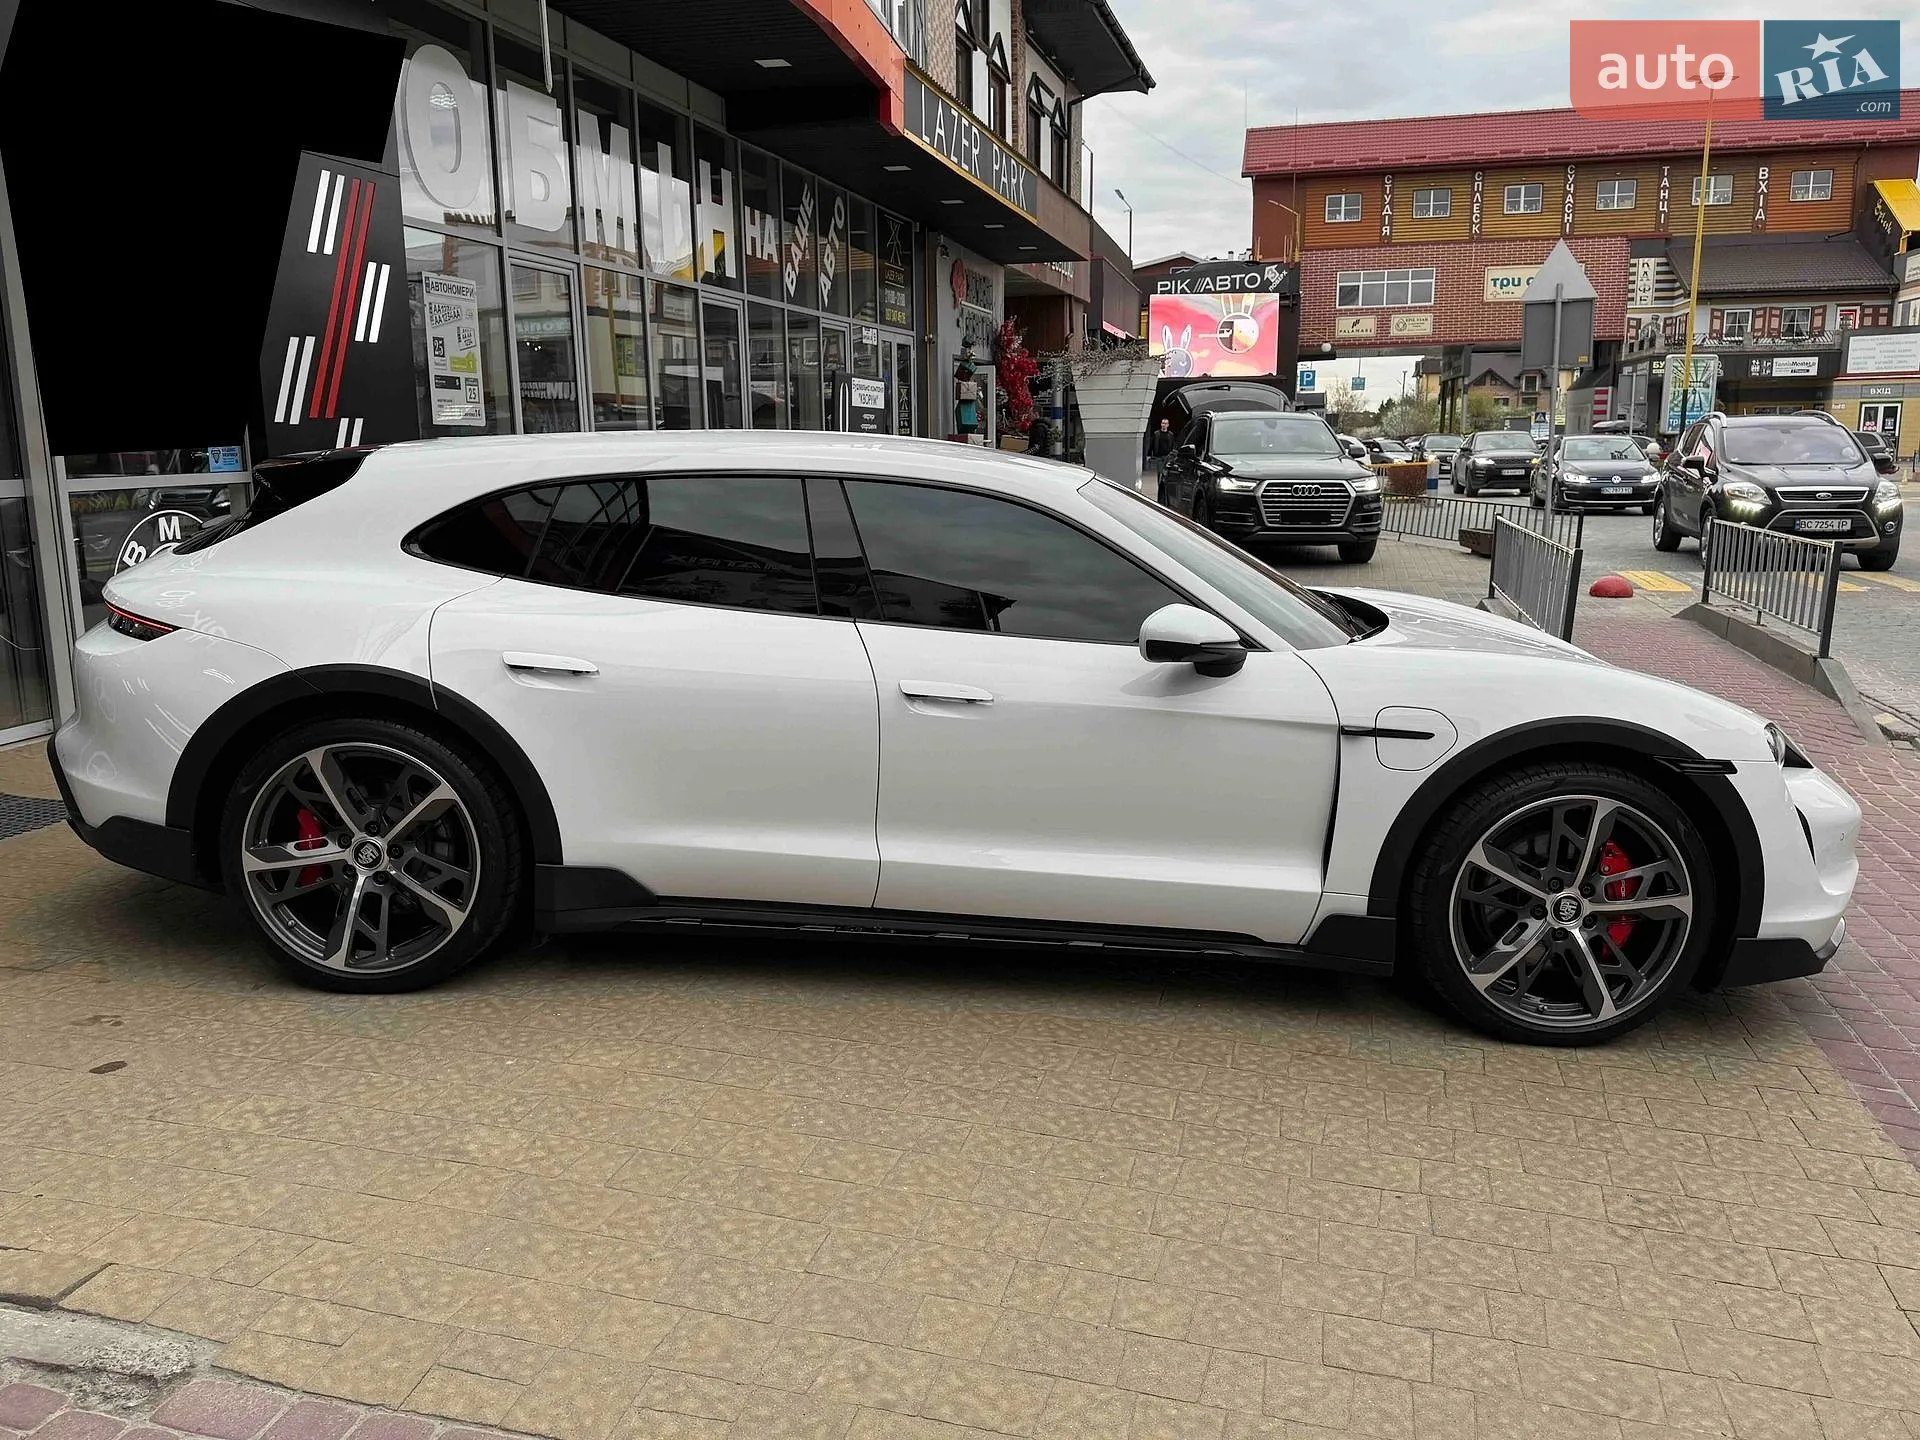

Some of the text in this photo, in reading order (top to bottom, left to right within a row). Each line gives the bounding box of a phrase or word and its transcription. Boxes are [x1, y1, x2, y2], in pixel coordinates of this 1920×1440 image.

[921, 83, 1027, 212] LAZER PARK
[1381, 174, 1393, 236] СТУДІЯ
[1472, 171, 1483, 234] СПЛЕСК
[1564, 164, 1576, 233] СУЧАСНІ
[1659, 166, 1670, 224] ТАНЦІ
[744, 204, 779, 264] НА
[785, 182, 814, 298] ВАШЕ
[820, 195, 845, 309] АВТО
[430, 281, 474, 299] АВТОНОМЕРИ
[1814, 520, 1834, 529] 7254
